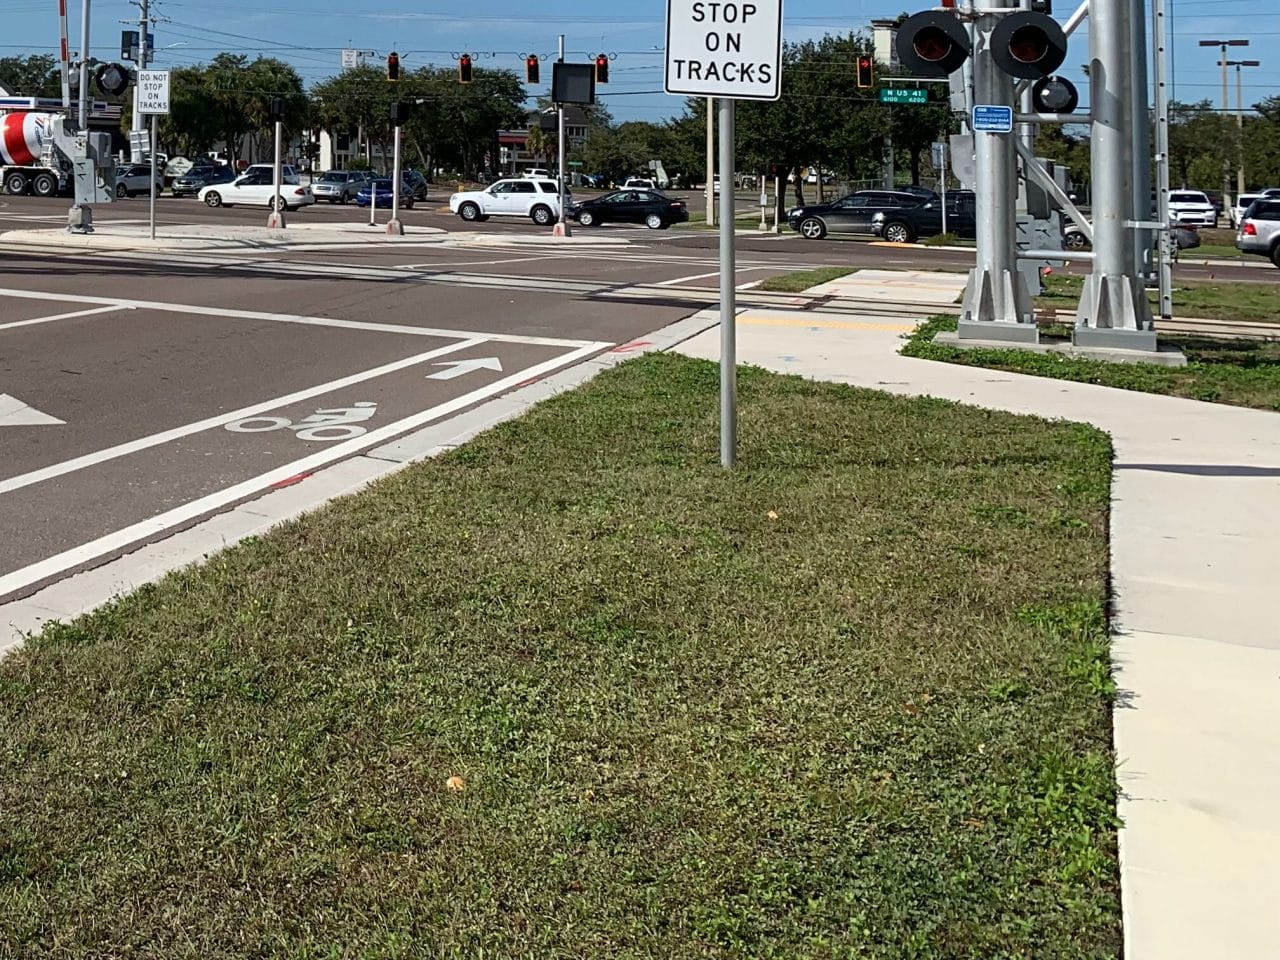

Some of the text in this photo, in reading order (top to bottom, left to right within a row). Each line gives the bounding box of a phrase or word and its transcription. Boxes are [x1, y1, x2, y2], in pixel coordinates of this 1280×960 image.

[692, 3, 756, 23] STOP
[705, 32, 741, 52] ON
[673, 60, 771, 83] TRACKS
[144, 83, 163, 91] STOP
[139, 101, 167, 109] TRACKS
